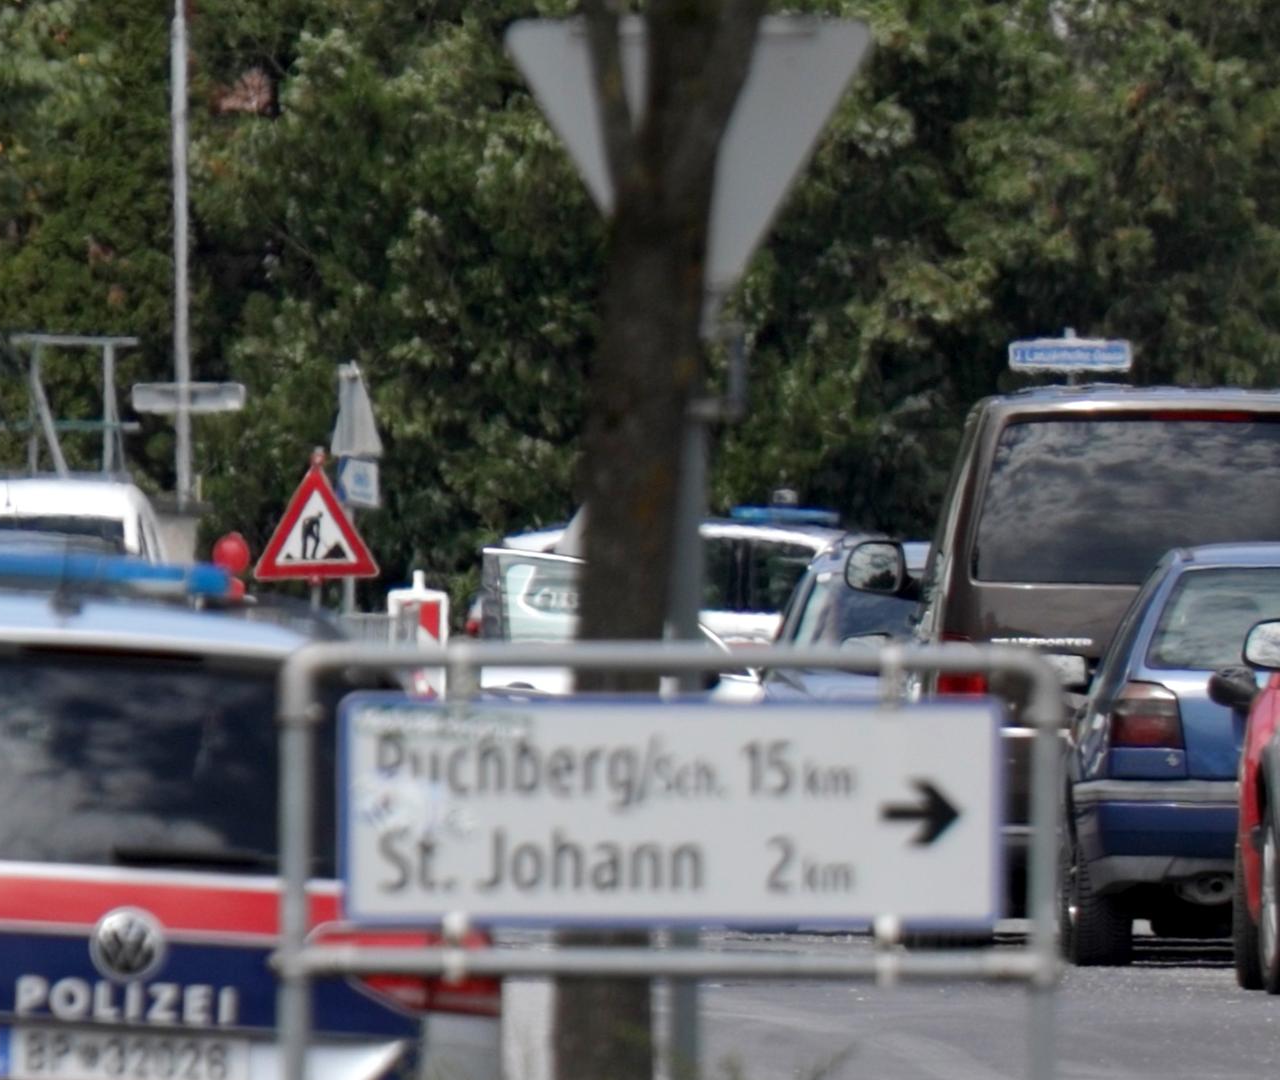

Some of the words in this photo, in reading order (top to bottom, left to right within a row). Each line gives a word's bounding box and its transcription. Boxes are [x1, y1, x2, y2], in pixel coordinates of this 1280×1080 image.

[742, 739, 795, 797] 15
[803, 760, 857, 796] km
[377, 827, 456, 893] St.
[476, 826, 704, 892] Johann
[765, 834, 795, 893] 2
[802, 857, 857, 894] km
[14, 974, 238, 1027] POLIZEI
